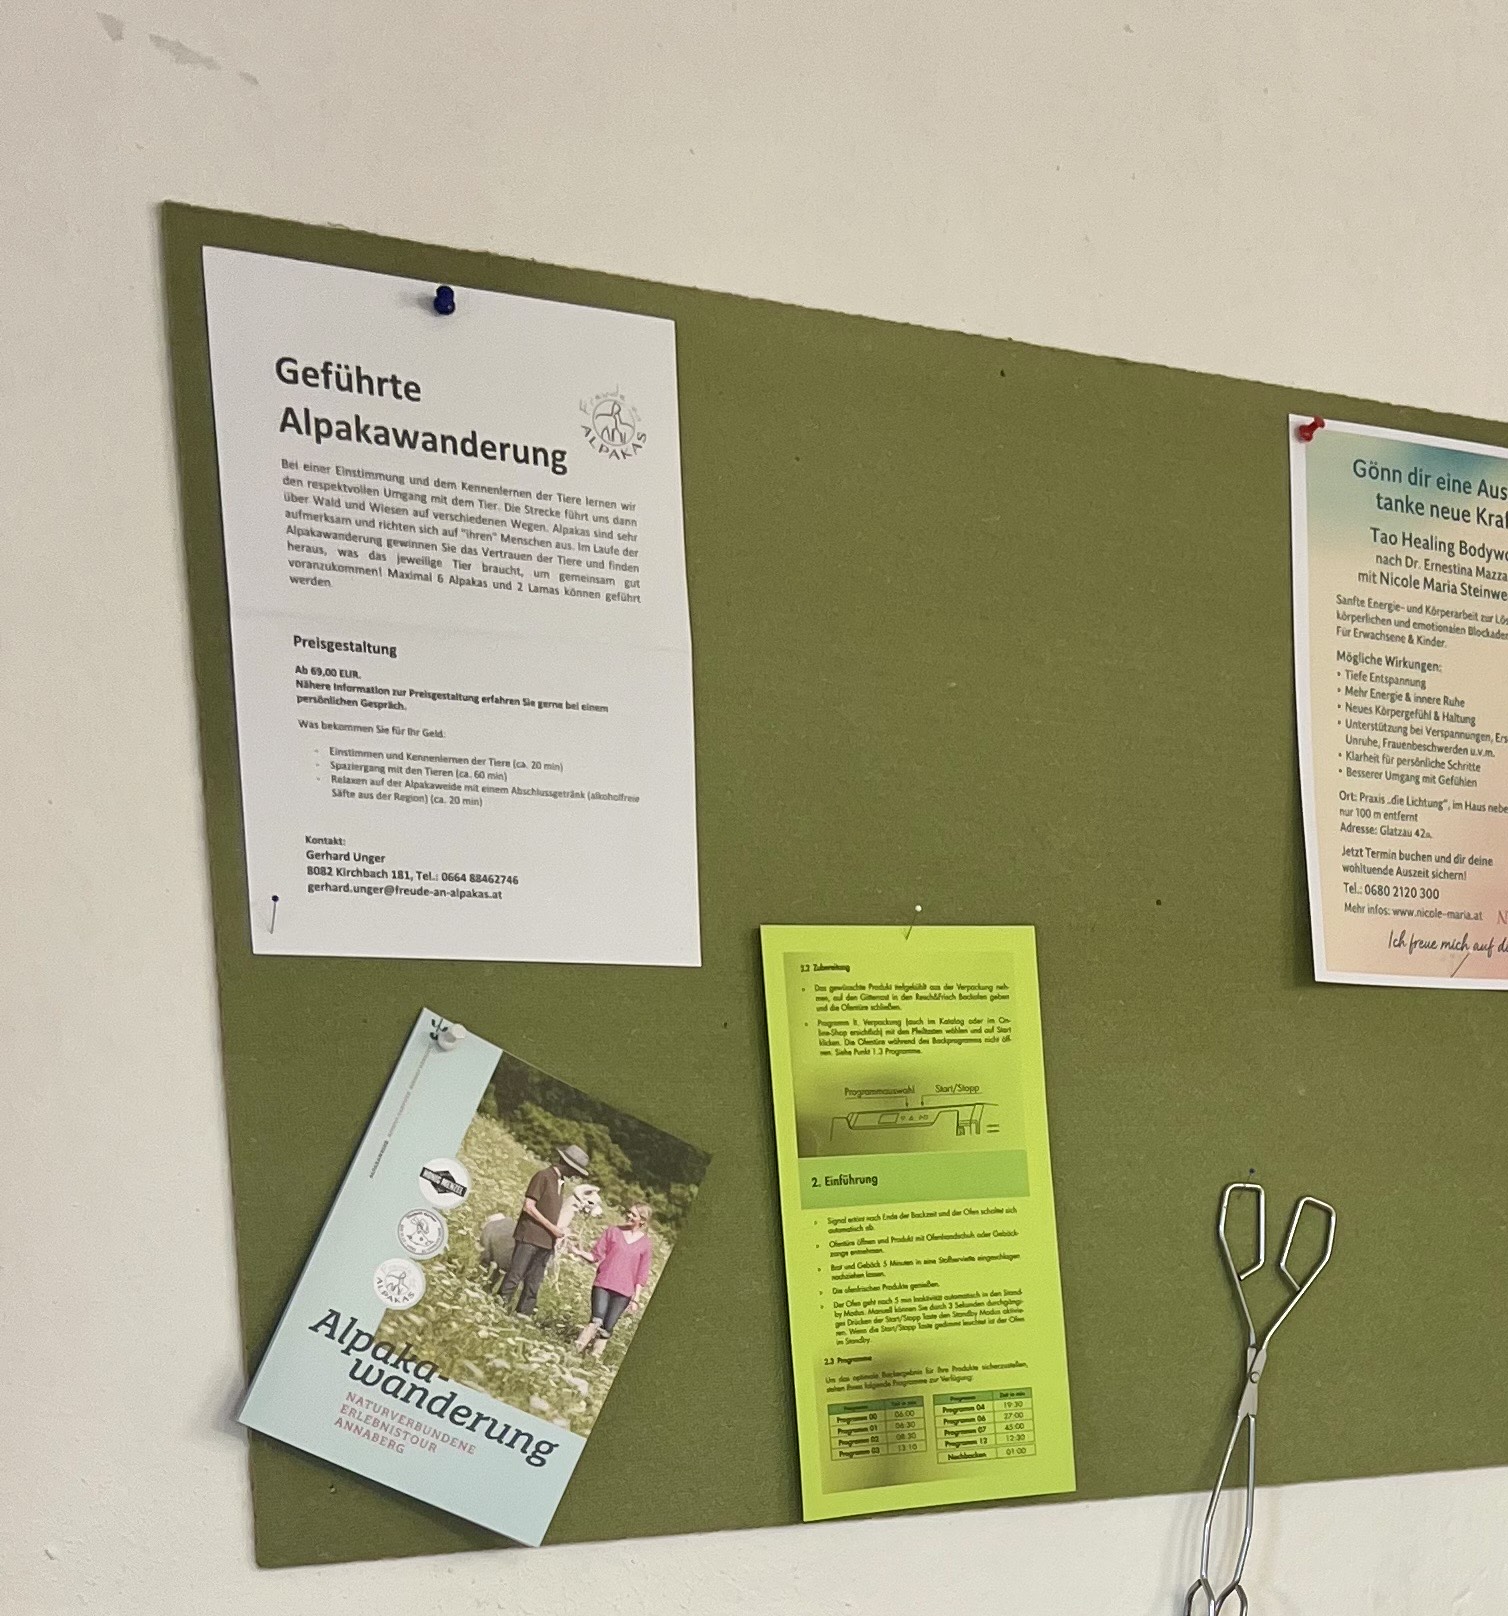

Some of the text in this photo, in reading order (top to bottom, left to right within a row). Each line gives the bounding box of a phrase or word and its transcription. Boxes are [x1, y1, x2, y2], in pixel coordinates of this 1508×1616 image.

[274, 356, 421, 402] Geführte
[279, 406, 568, 476] Alpakawanderung
[581, 425, 647, 460] ALPAKAS
[1352, 458, 1402, 484] Gönn
[1407, 466, 1432, 488] dir
[1436, 471, 1472, 495] eine
[1375, 492, 1425, 516] tanke
[1429, 503, 1471, 524] neue
[1369, 526, 1398, 546] Tao
[1401, 531, 1455, 558] Healing
[1375, 553, 1402, 567] nach
[1404, 554, 1421, 569] Dr.
[1423, 557, 1473, 577] Ernestina
[1357, 571, 1377, 585] mit
[1379, 570, 1420, 590] Nicole
[1422, 575, 1458, 595] Maria
[292, 634, 397, 659] Preisgestaltung
[1336, 649, 1442, 673] Mögliche Wirkungen:
[304, 834, 345, 846] Kontakt:
[305, 849, 386, 865] Gerhard Unger
[306, 865, 519, 885] 8082 Kirchbach 181, Tel.: 0664 88462746
[307, 881, 503, 900] gerhard.unger@freude-an-alpakas.at
[1342, 881, 1440, 900] Tel.: 0680 2120 300
[1388, 930, 1408, 948] Ich
[1408, 931, 1438, 955] freue
[1440, 933, 1470, 951] mich
[1472, 938, 1495, 959] auf
[824, 1174, 878, 1188] Einführung
[309, 1308, 450, 1383] Alpaka-
[345, 1391, 477, 1456] NATURVERBUNDENE
[349, 1358, 560, 1468] wanderung
[334, 1415, 406, 1455] ANNABERG
[339, 1403, 438, 1454] ERLEBNISTOUR
